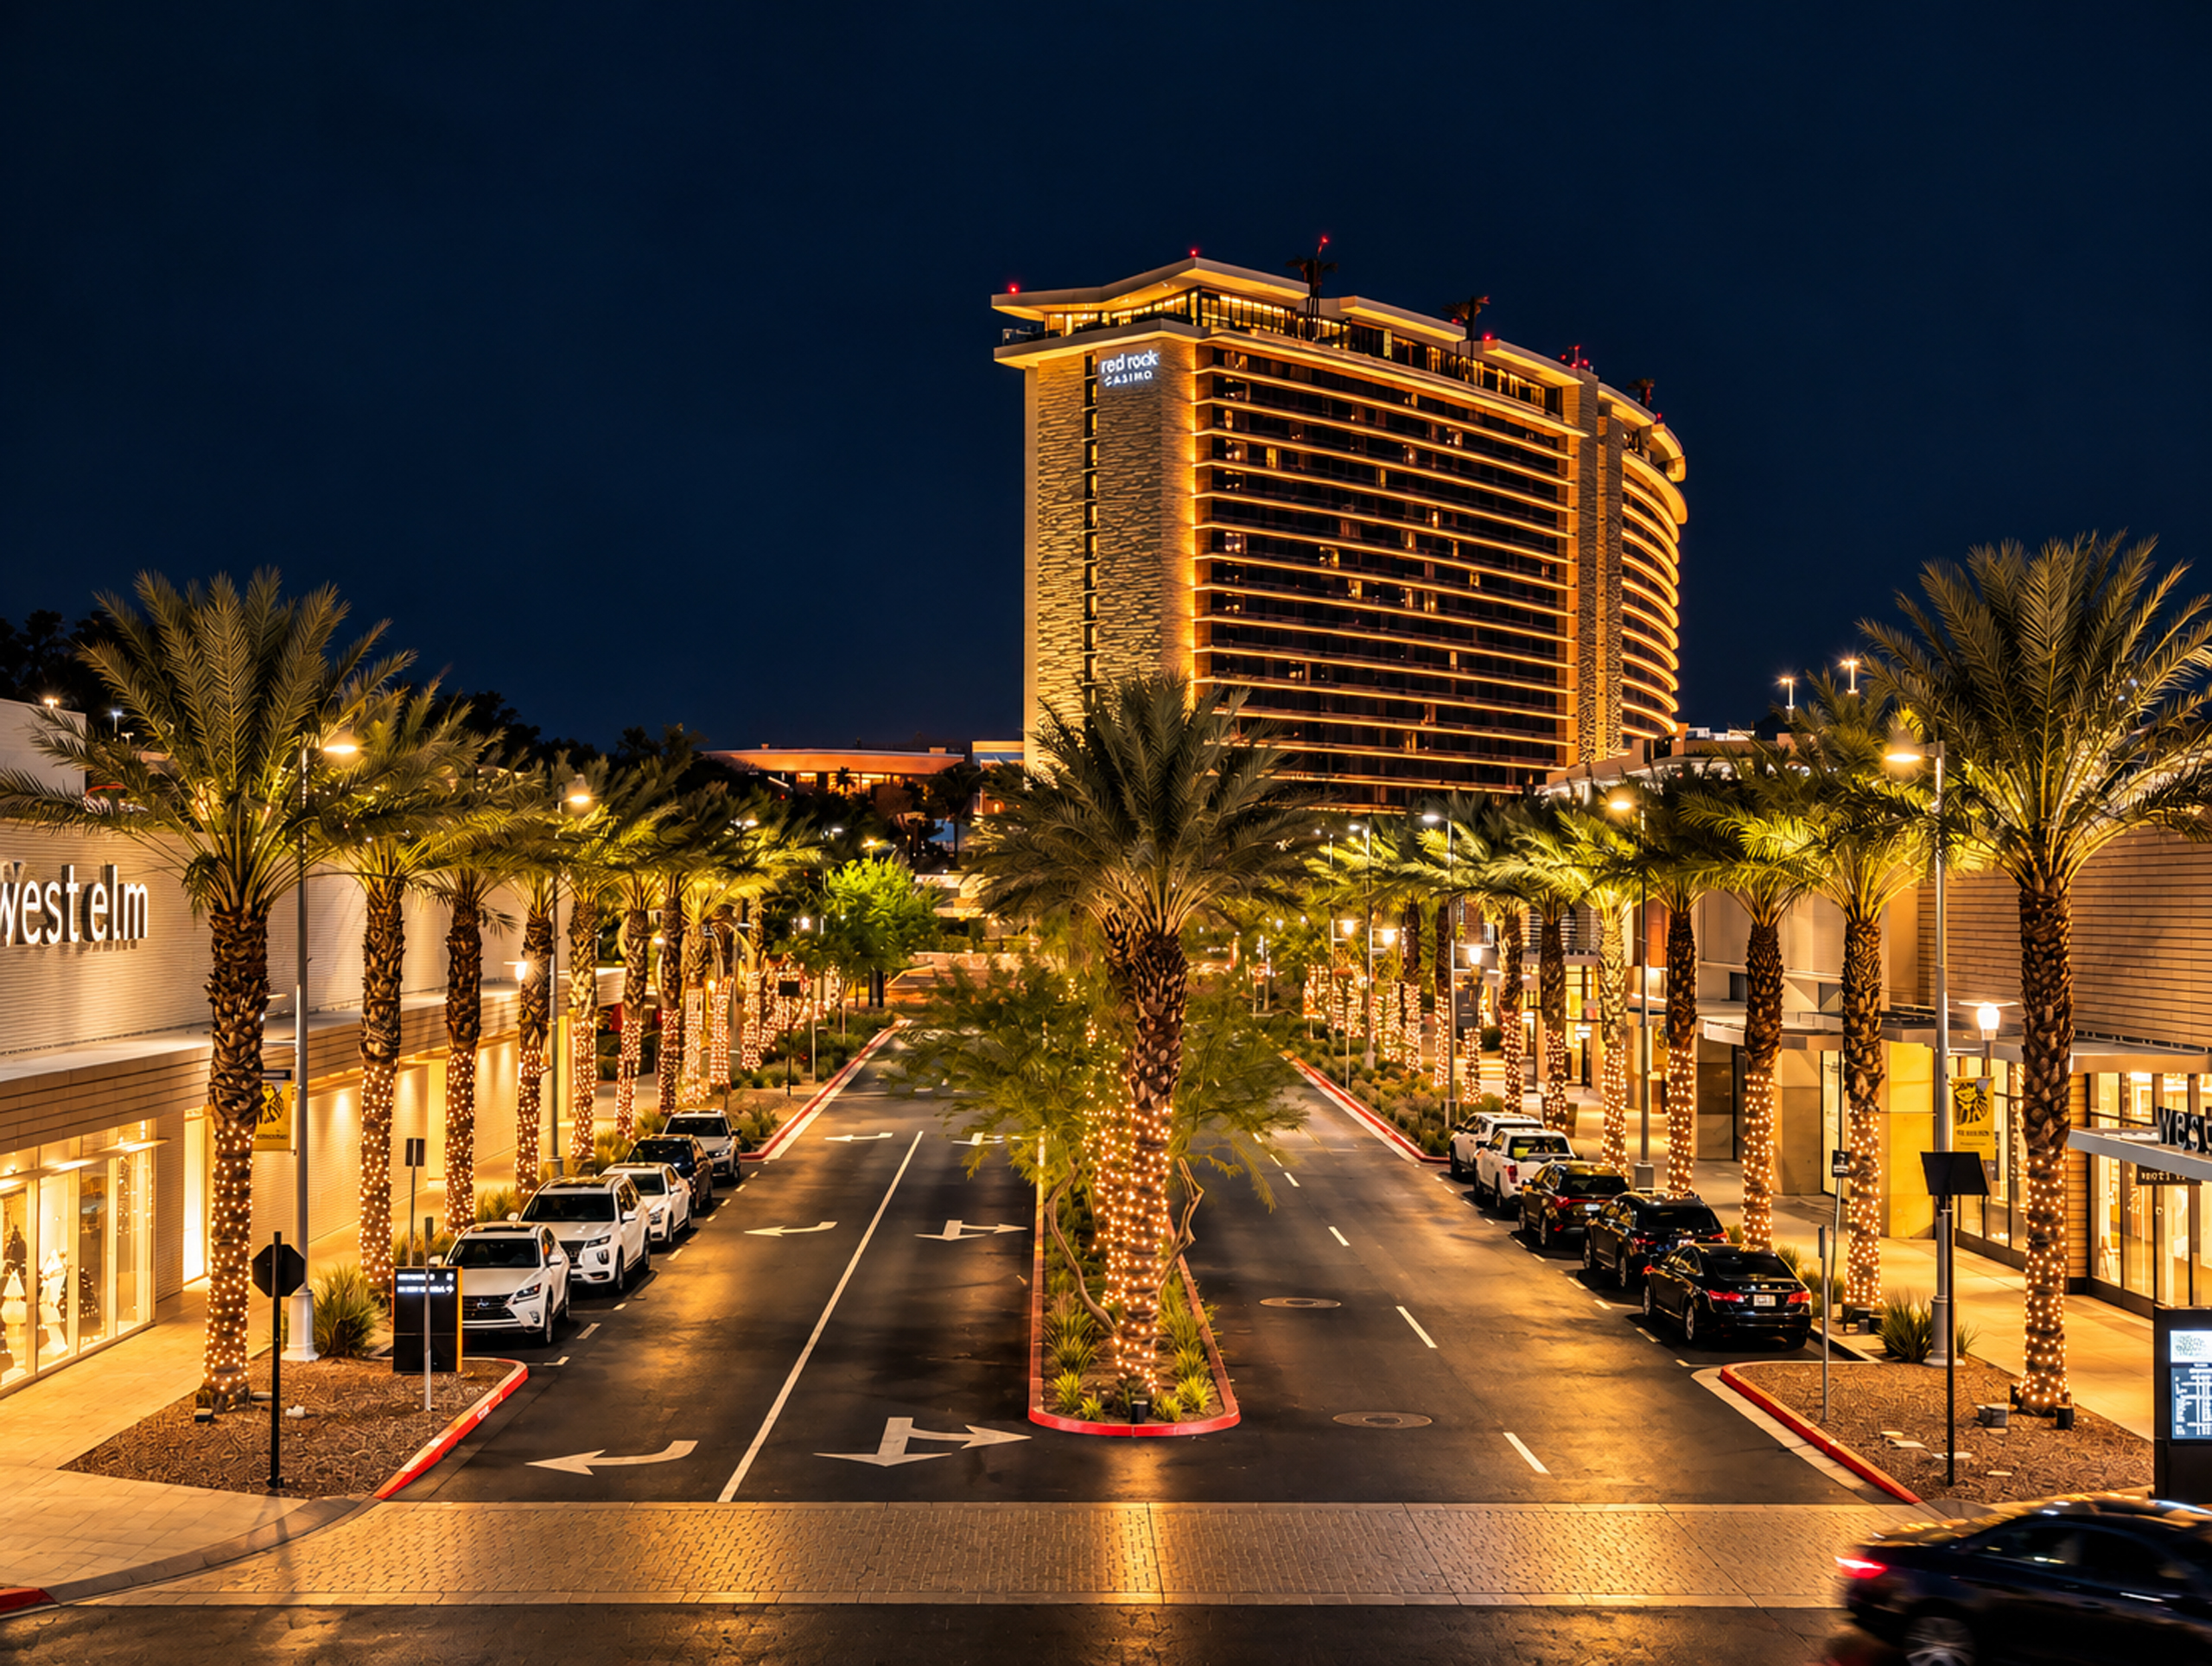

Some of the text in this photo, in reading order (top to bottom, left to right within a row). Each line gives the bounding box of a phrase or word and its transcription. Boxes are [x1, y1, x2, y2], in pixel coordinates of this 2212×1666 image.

[1101, 349, 1159, 373] red rock
[90, 864, 149, 943] elm
